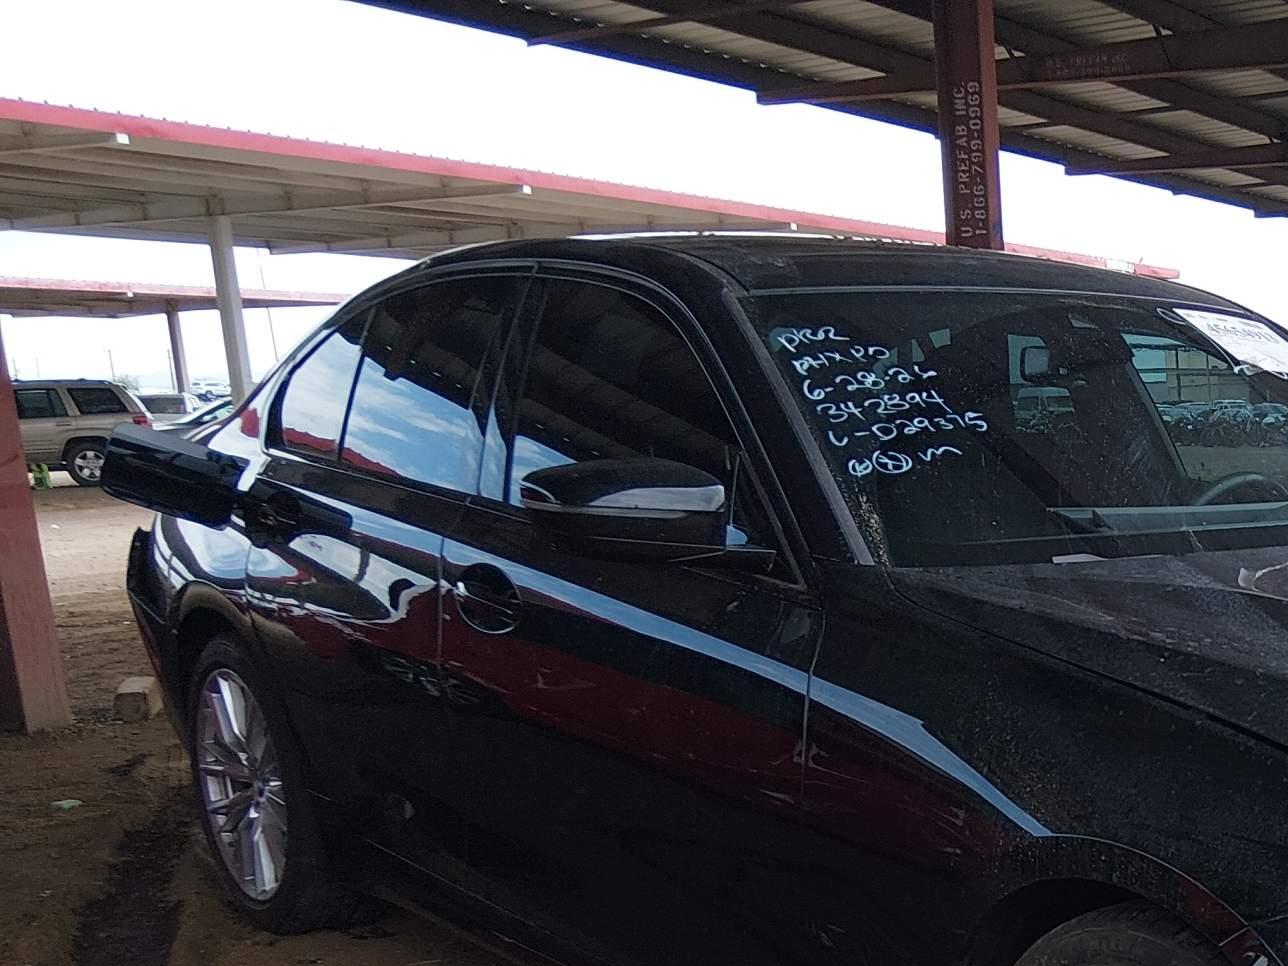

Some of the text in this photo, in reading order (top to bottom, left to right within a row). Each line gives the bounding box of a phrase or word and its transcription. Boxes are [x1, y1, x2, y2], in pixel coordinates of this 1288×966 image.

[954, 81, 967, 116] INC.
[955, 125, 971, 194] PREFAB
[967, 81, 988, 236] 1-866-799-0969
